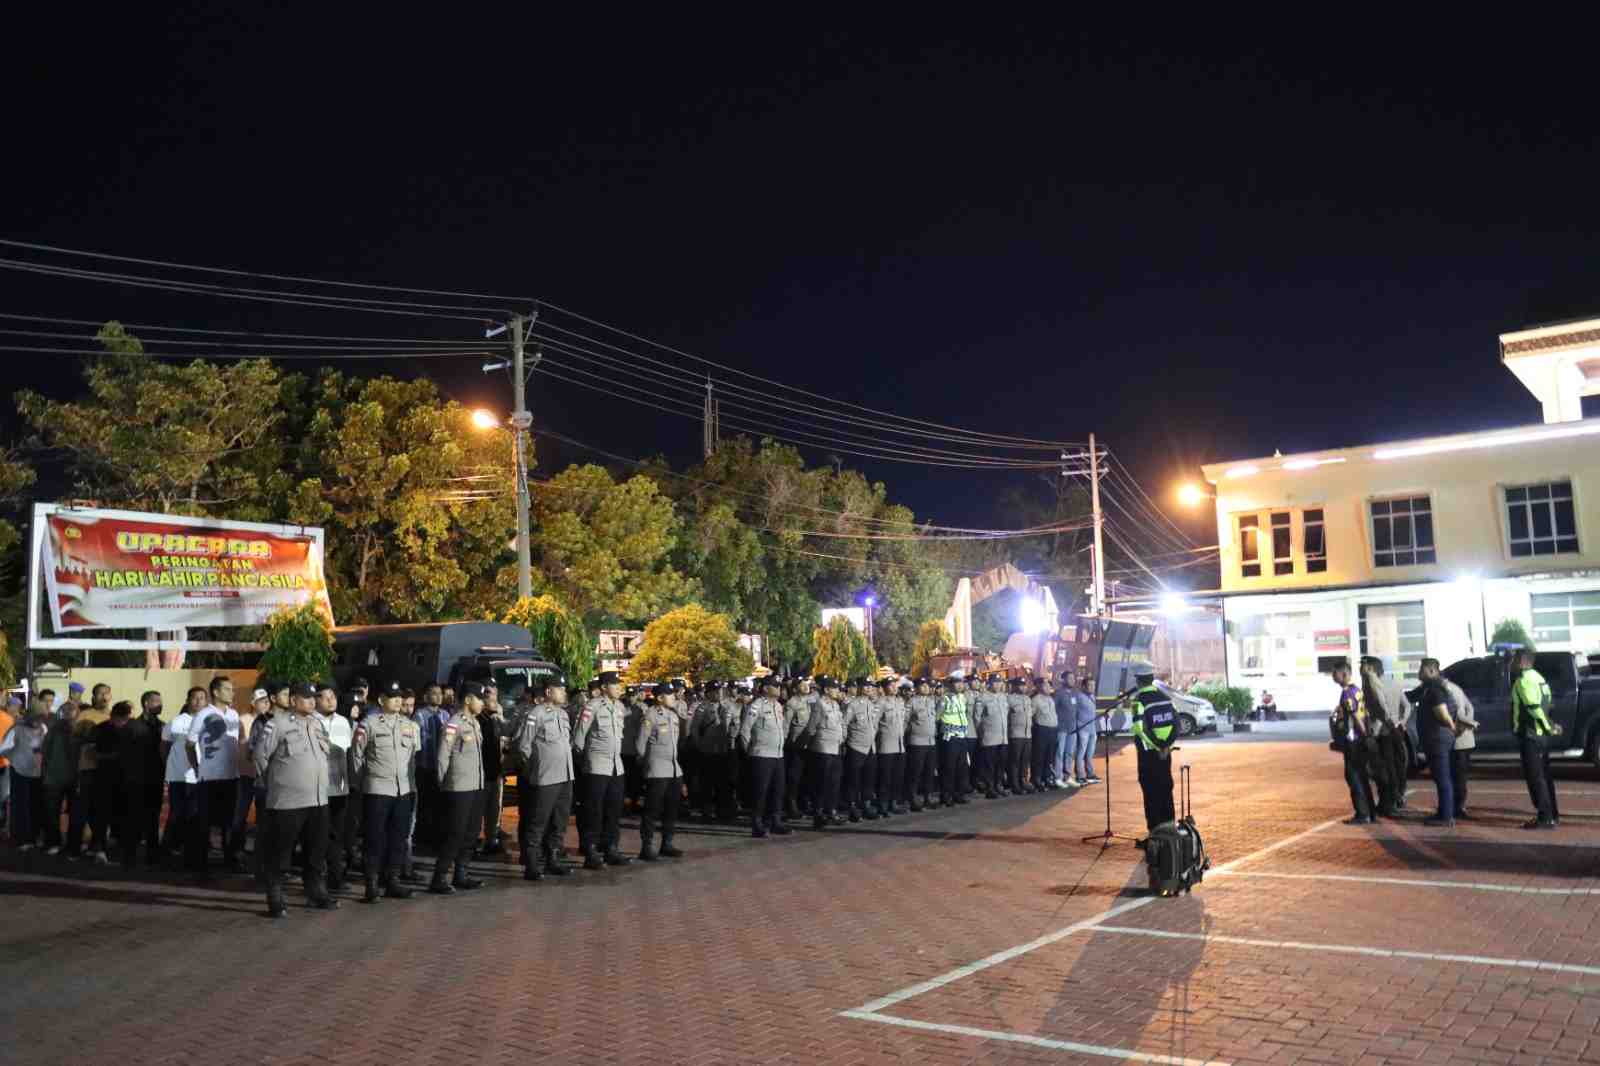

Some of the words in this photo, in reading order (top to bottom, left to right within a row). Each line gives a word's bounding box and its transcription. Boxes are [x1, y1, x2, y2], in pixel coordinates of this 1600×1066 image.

[117, 532, 272, 558] UPACARA
[95, 571, 144, 588] HARI
[148, 571, 206, 588] LAHIR
[206, 573, 305, 589] PANCASILA
[1153, 712, 1173, 723] POLISI
